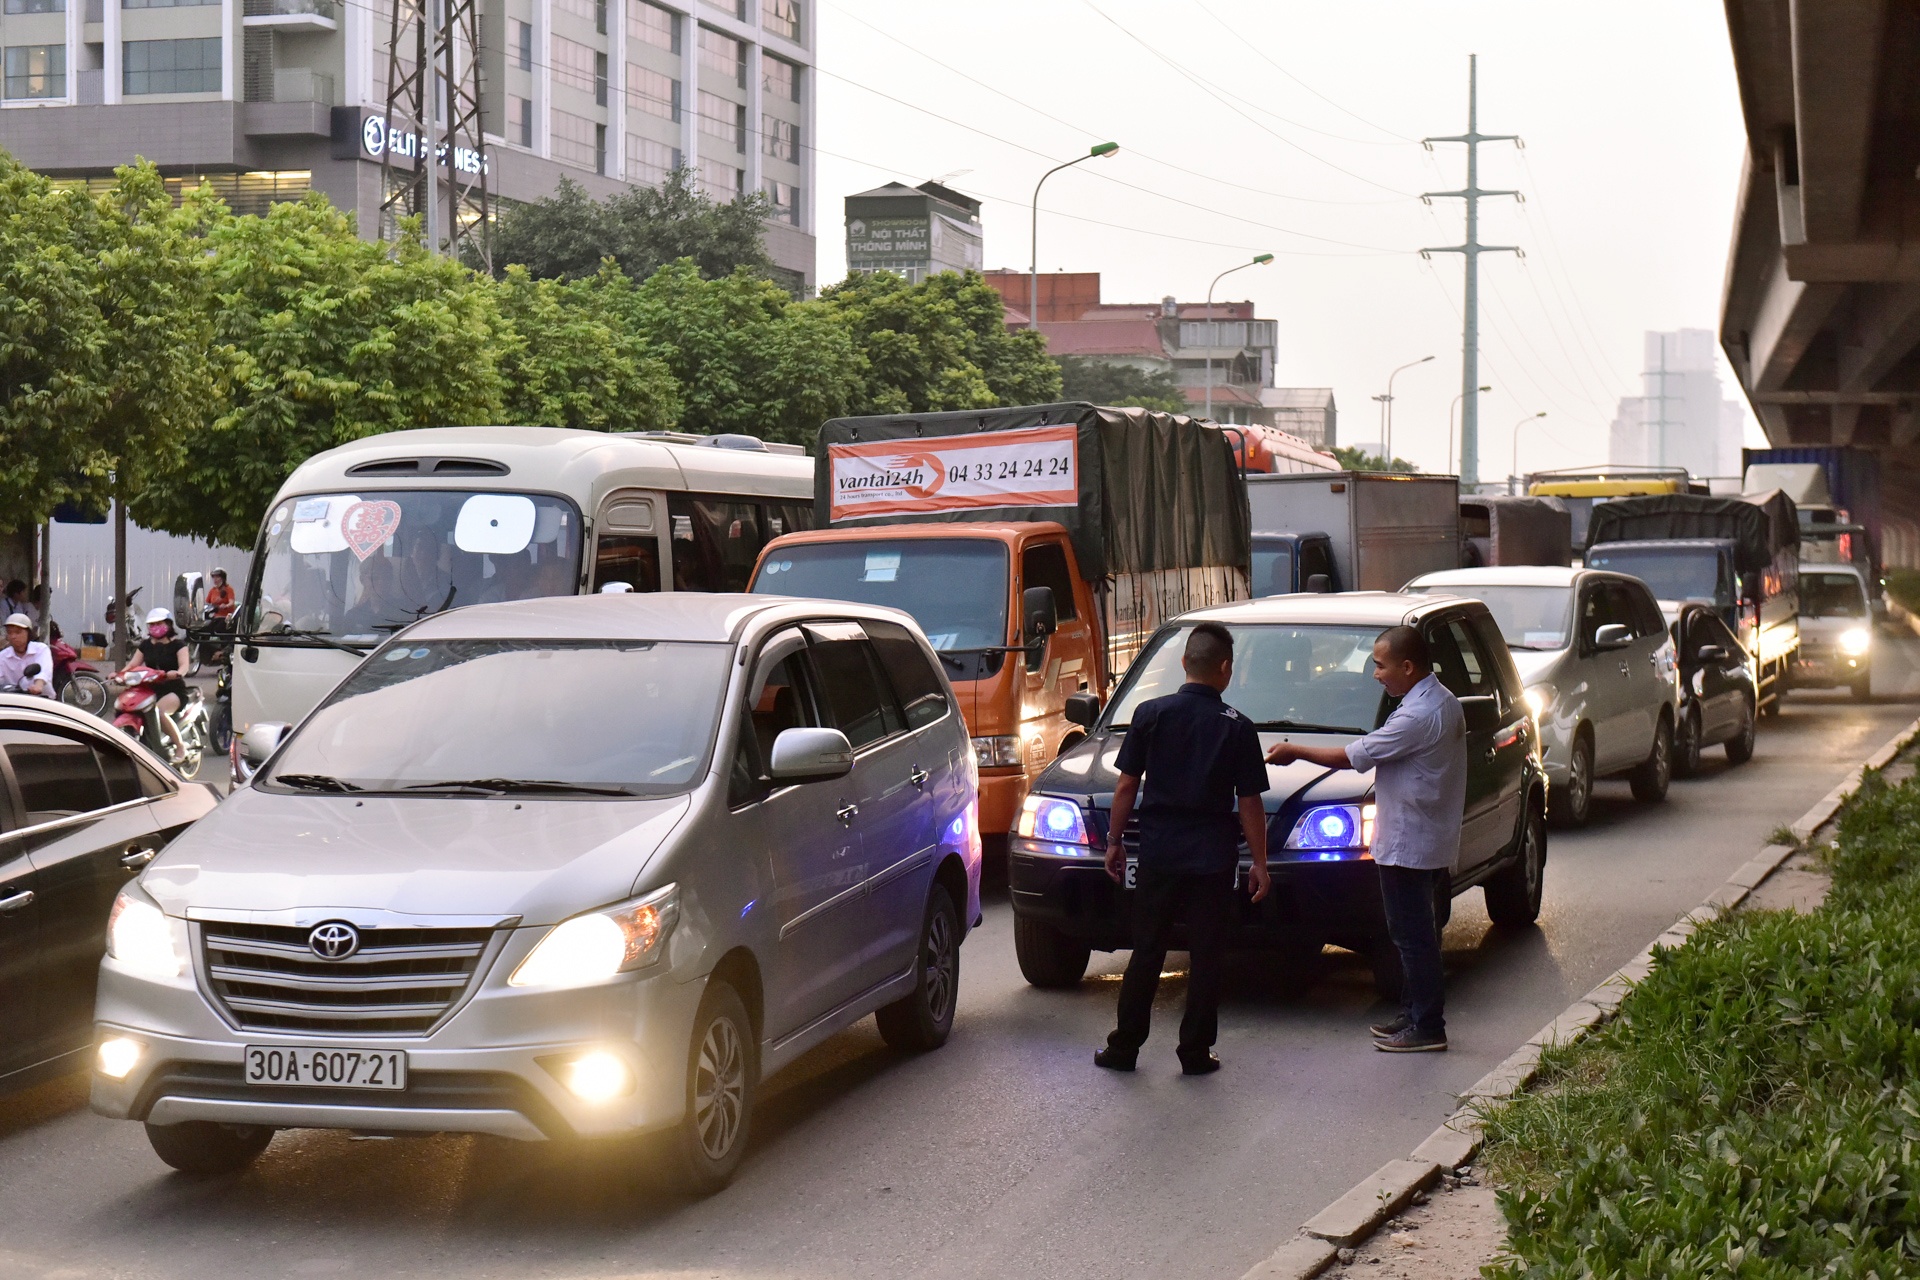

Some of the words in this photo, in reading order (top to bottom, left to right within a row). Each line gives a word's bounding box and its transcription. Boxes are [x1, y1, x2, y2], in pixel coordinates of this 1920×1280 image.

[871, 228, 892, 240] NỘI
[894, 226, 927, 238] THẤT
[850, 241, 892, 252] THÔNG
[949, 465, 968, 483] 04
[973, 463, 993, 481] 33
[998, 460, 1018, 479] 24
[1023, 458, 1043, 477] 24
[1049, 457, 1069, 476] 24
[839, 469, 924, 489] vantai24h
[861, 491, 884, 499] transport
[250, 1050, 397, 1086] 30A-607.21
